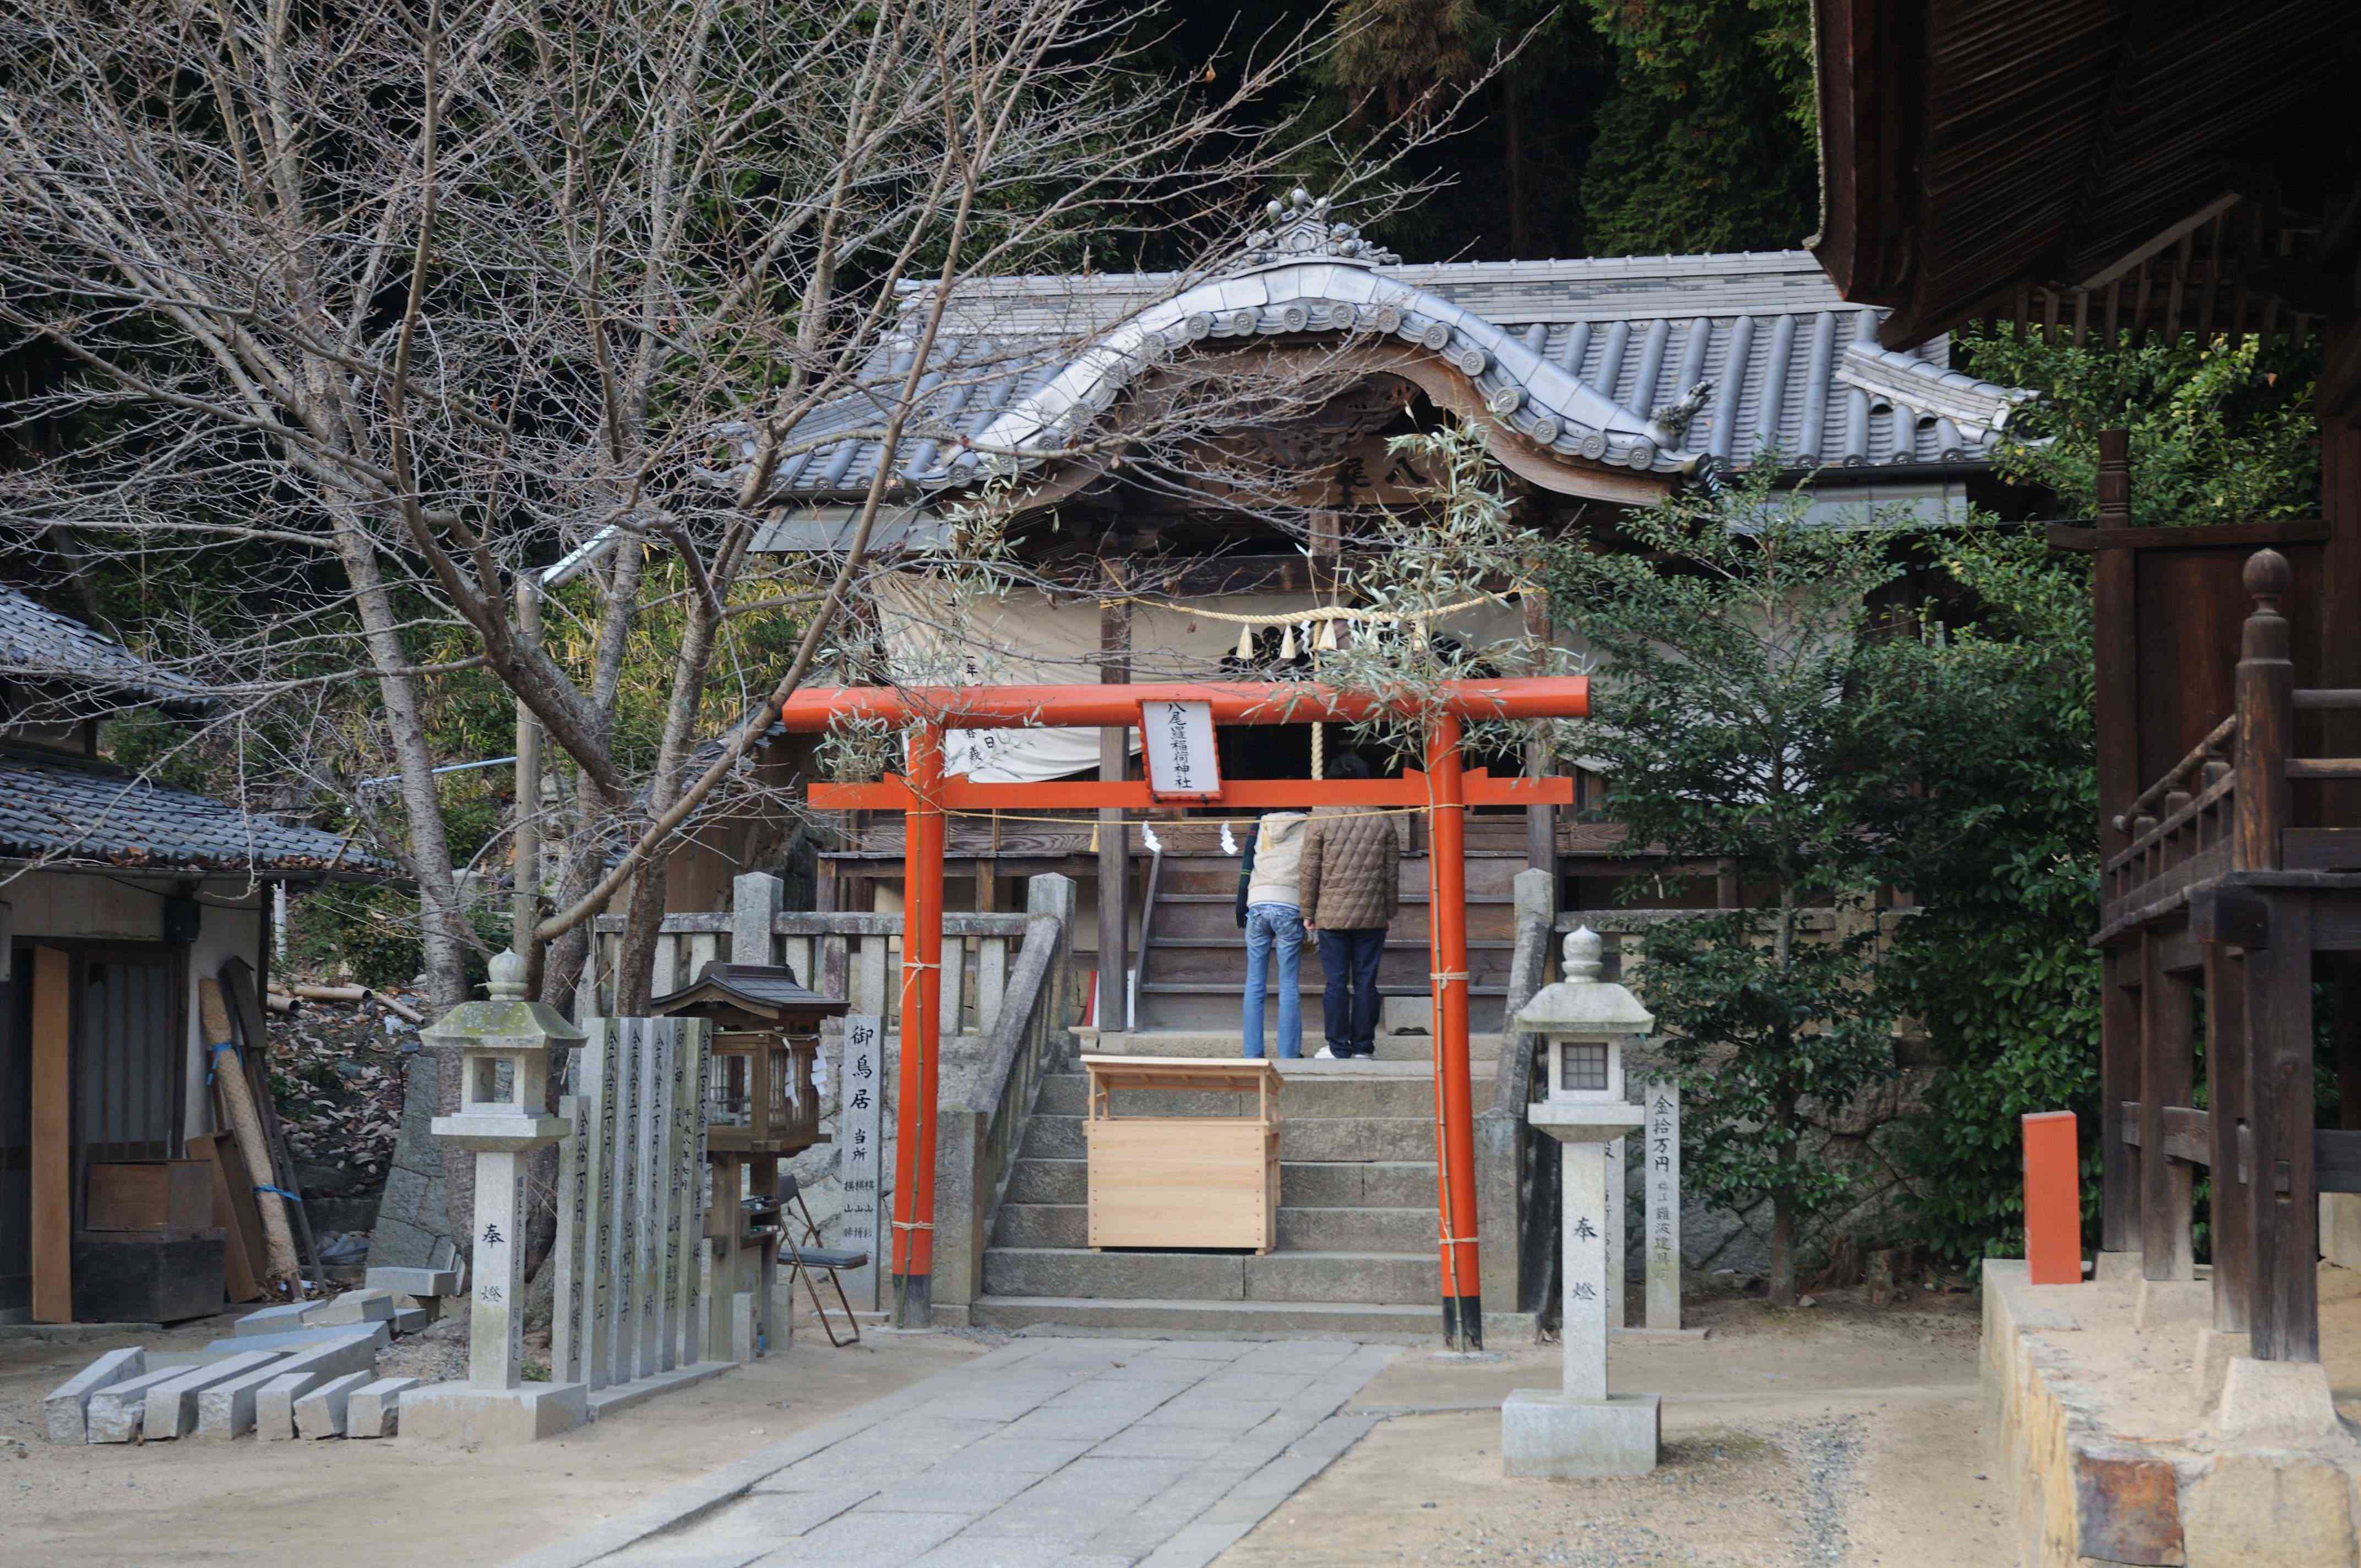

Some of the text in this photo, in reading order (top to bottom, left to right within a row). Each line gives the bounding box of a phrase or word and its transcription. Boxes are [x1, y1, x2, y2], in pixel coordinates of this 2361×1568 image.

[850, 1025, 874, 1161] 御鳥居 当所
[1652, 1094, 1674, 1172] 金拾万円
